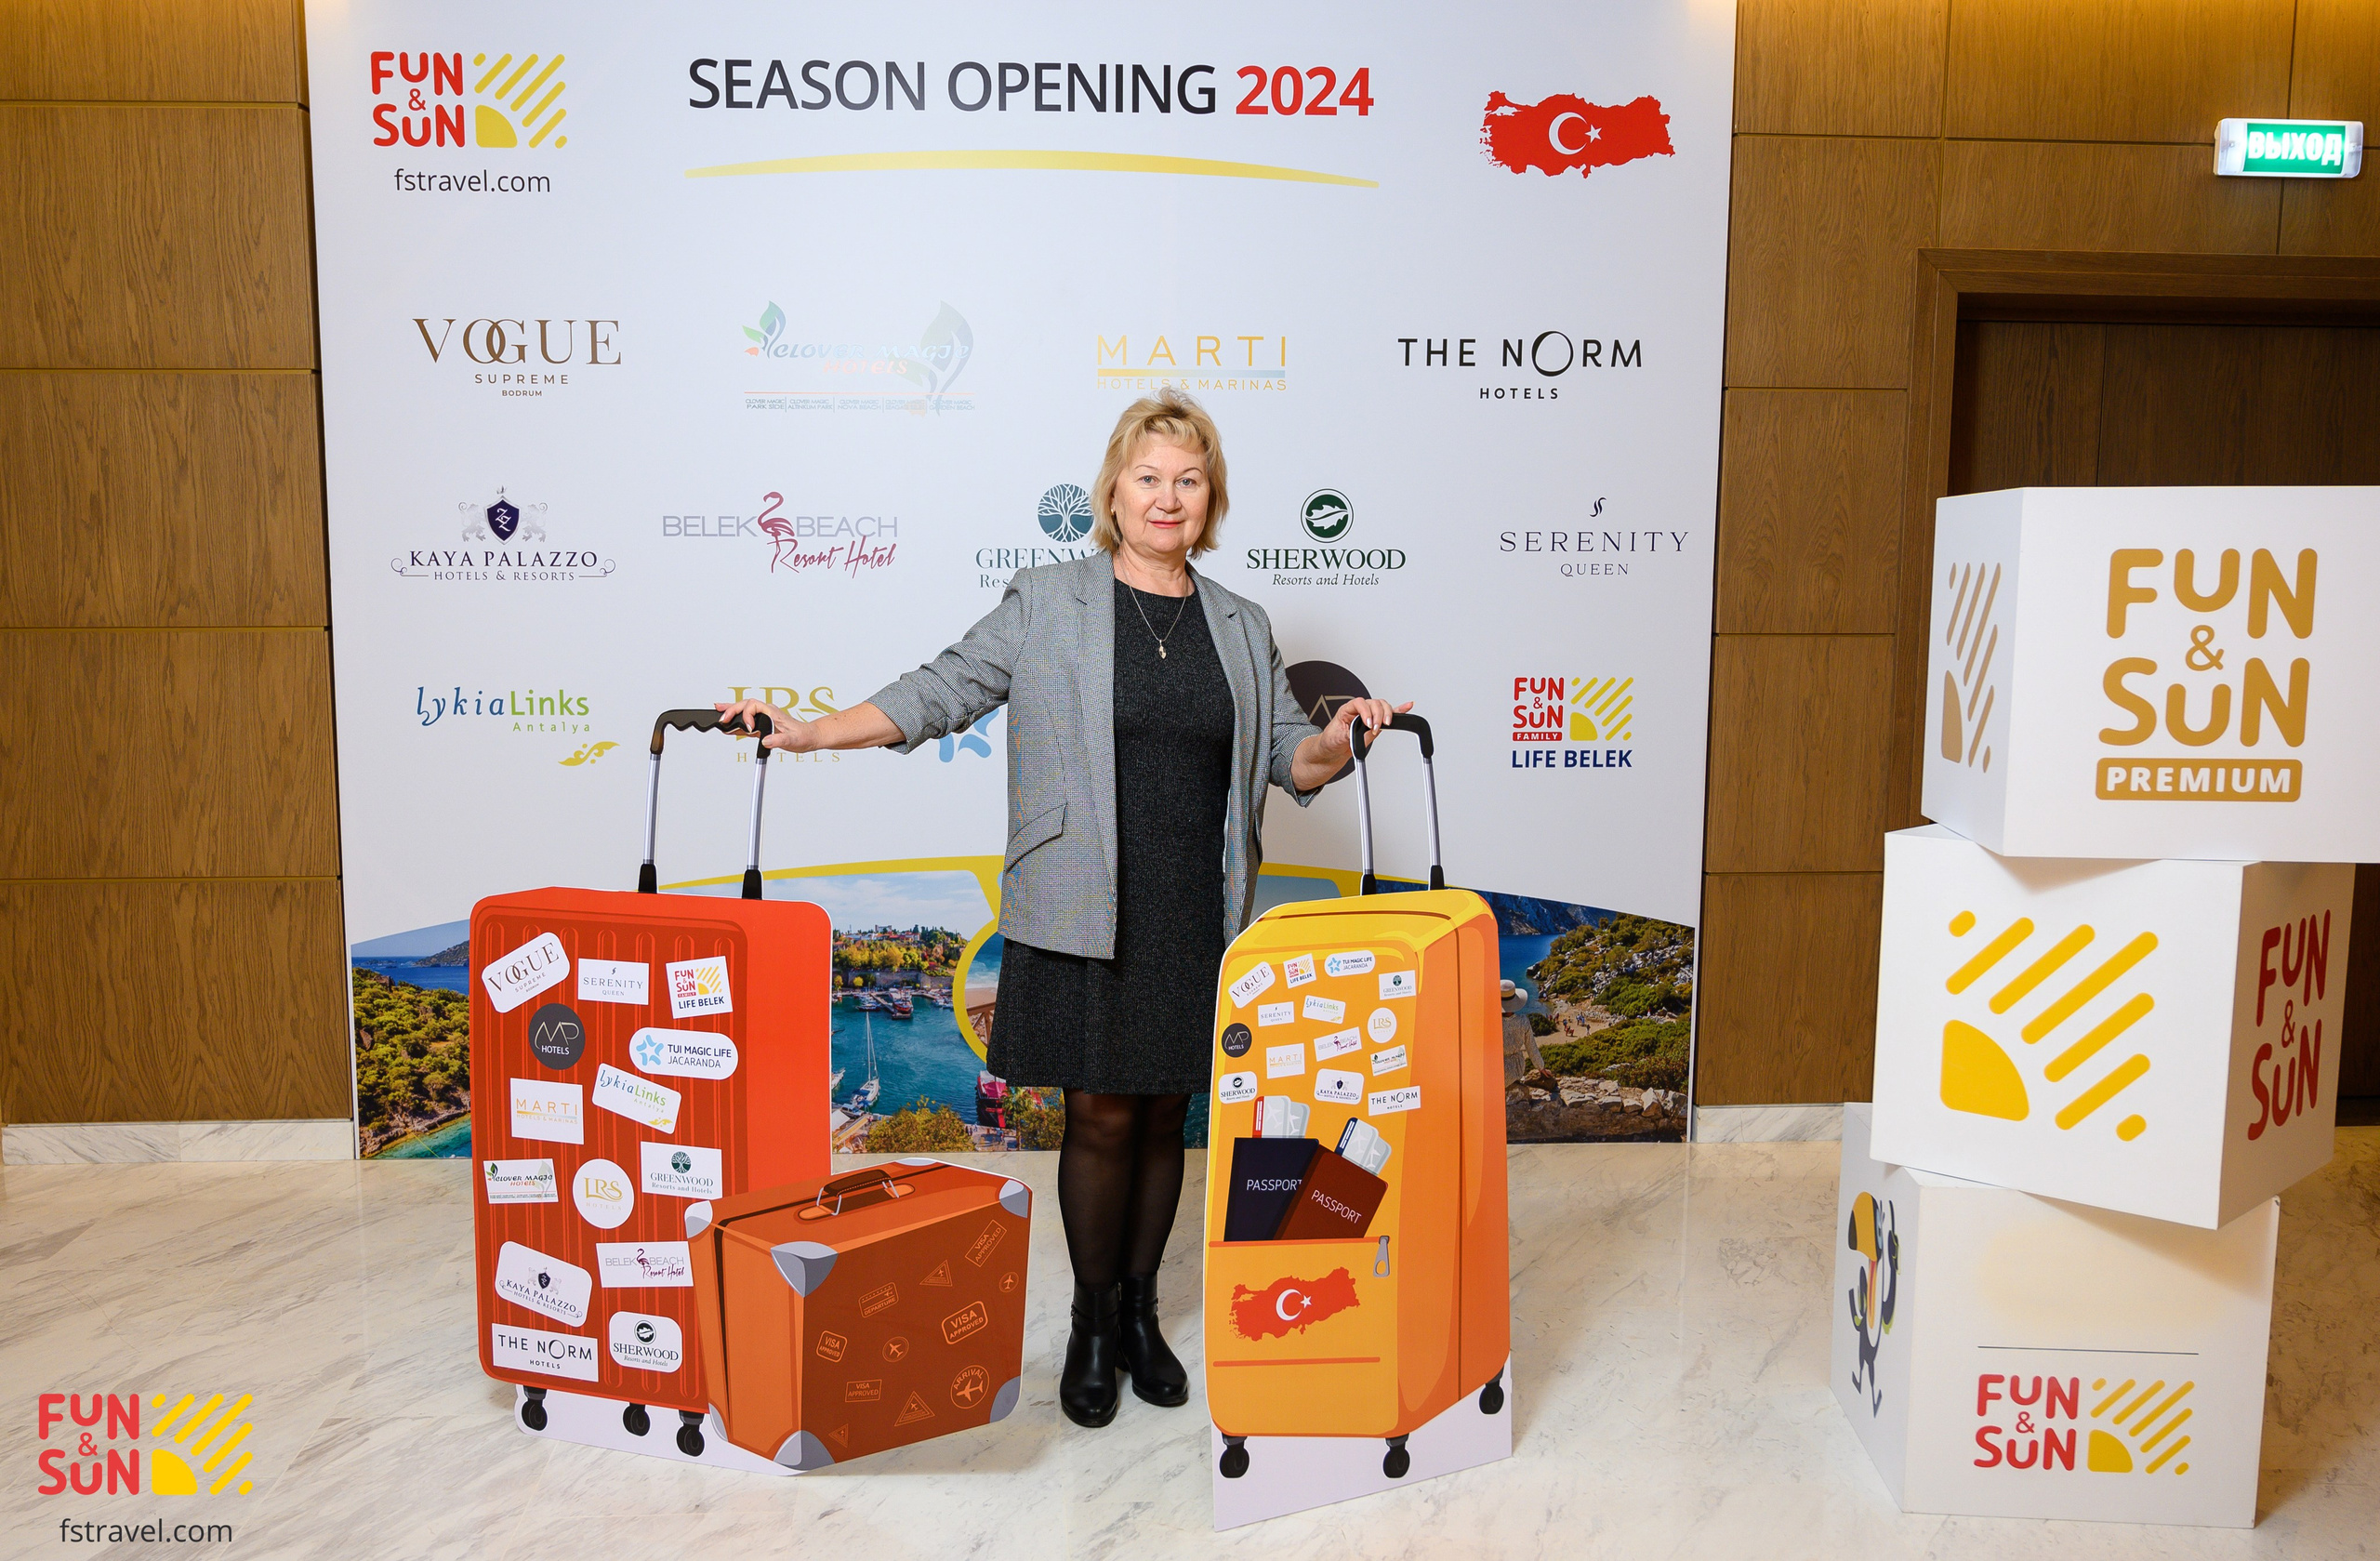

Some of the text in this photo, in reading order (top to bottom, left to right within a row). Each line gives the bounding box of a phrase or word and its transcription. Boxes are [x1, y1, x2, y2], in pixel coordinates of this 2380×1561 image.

[371, 51, 464, 96] FUN
[688, 58, 1374, 117] SEASON OPENING 2024
[408, 88, 427, 112] &
[373, 104, 466, 149] SUN
[2248, 131, 2342, 165] ВЫХОД
[393, 168, 551, 193] fstravel.com
[412, 318, 622, 364] VOGUE
[1097, 335, 1286, 366] MARTI
[773, 343, 970, 360] CLOVER MAGIC
[1397, 330, 1643, 377] THE NORM
[822, 359, 908, 375] HOTELS
[474, 374, 569, 385] SUPREME
[1097, 378, 1287, 390] HOTELS & MARINAS
[1479, 388, 1559, 400] HOTELS
[662, 515, 898, 537] BELEK BEACH
[1500, 532, 1689, 552] SERENITY
[410, 550, 598, 568] KAYA PALAZZO
[766, 535, 897, 579] Resort Hotel
[1247, 549, 1407, 570] SHERWOOD
[434, 571, 575, 581] HOTELS & RESORTS
[1272, 574, 1380, 586] Resorts and Hotels
[1560, 563, 1629, 577] QUEEN
[2106, 548, 2318, 640] FUN
[2185, 625, 2225, 671] &
[1514, 677, 1564, 701] FUN
[1533, 696, 1543, 709] &
[2098, 657, 2310, 747] SUN
[1513, 705, 1564, 728] SUN
[512, 721, 590, 734] Antalya
[736, 752, 840, 762] HTELS
[1512, 750, 1633, 768] LIFE BELEK
[2106, 766, 2292, 794] PREMIUM
[488, 942, 560, 993] VOGUE
[674, 969, 694, 981] FUN
[2256, 909, 2331, 1027] FUN
[514, 972, 547, 993] SUPREME
[583, 976, 643, 989] SERENITY
[1232, 966, 1269, 998] VOGUE
[678, 996, 724, 1010] LIFE BELEK
[1261, 1011, 1291, 1019] SERENITY
[535, 1021, 579, 1050] MP
[541, 1044, 570, 1055] HOTELS
[668, 1044, 732, 1058] TUI MAGIC LIFE
[1269, 1053, 1302, 1064] MARTI
[668, 1056, 721, 1068] JACARANDA
[2247, 1019, 2322, 1141] SUN
[1221, 1088, 1255, 1097] SHERWOOD
[1371, 1091, 1418, 1105] THE NORM
[516, 1098, 578, 1116] MARTI
[651, 1171, 713, 1187] GREENWOOD
[652, 1182, 676, 1190] Resorts
[691, 1186, 712, 1195] Hotels
[584, 1177, 624, 1202] LRS
[586, 1202, 622, 1210] HOTELS
[1311, 1189, 1362, 1224] PASSPORT
[974, 1233, 990, 1250] VISA
[975, 1227, 1001, 1263] APPROVED
[605, 1257, 684, 1266] BELEK BEACH
[506, 1279, 576, 1313] KAYA PALAZZO
[513, 1290, 535, 1303] HOTELS
[543, 1303, 566, 1316] RESORTS
[864, 1297, 896, 1316] DEPARTURE
[949, 1316, 984, 1340] APPROVED
[950, 1309, 978, 1329] VISA
[498, 1334, 592, 1360] THE NORM
[614, 1343, 679, 1361] SHERWOOD
[819, 1345, 840, 1357] APPROVED
[825, 1336, 840, 1350] VISA
[530, 1359, 561, 1369] HOTELS
[954, 1369, 985, 1390] ARRIVAL
[1977, 1374, 2080, 1420] FUN
[2016, 1411, 2035, 1434] &
[1973, 1425, 2077, 1471] SUN
